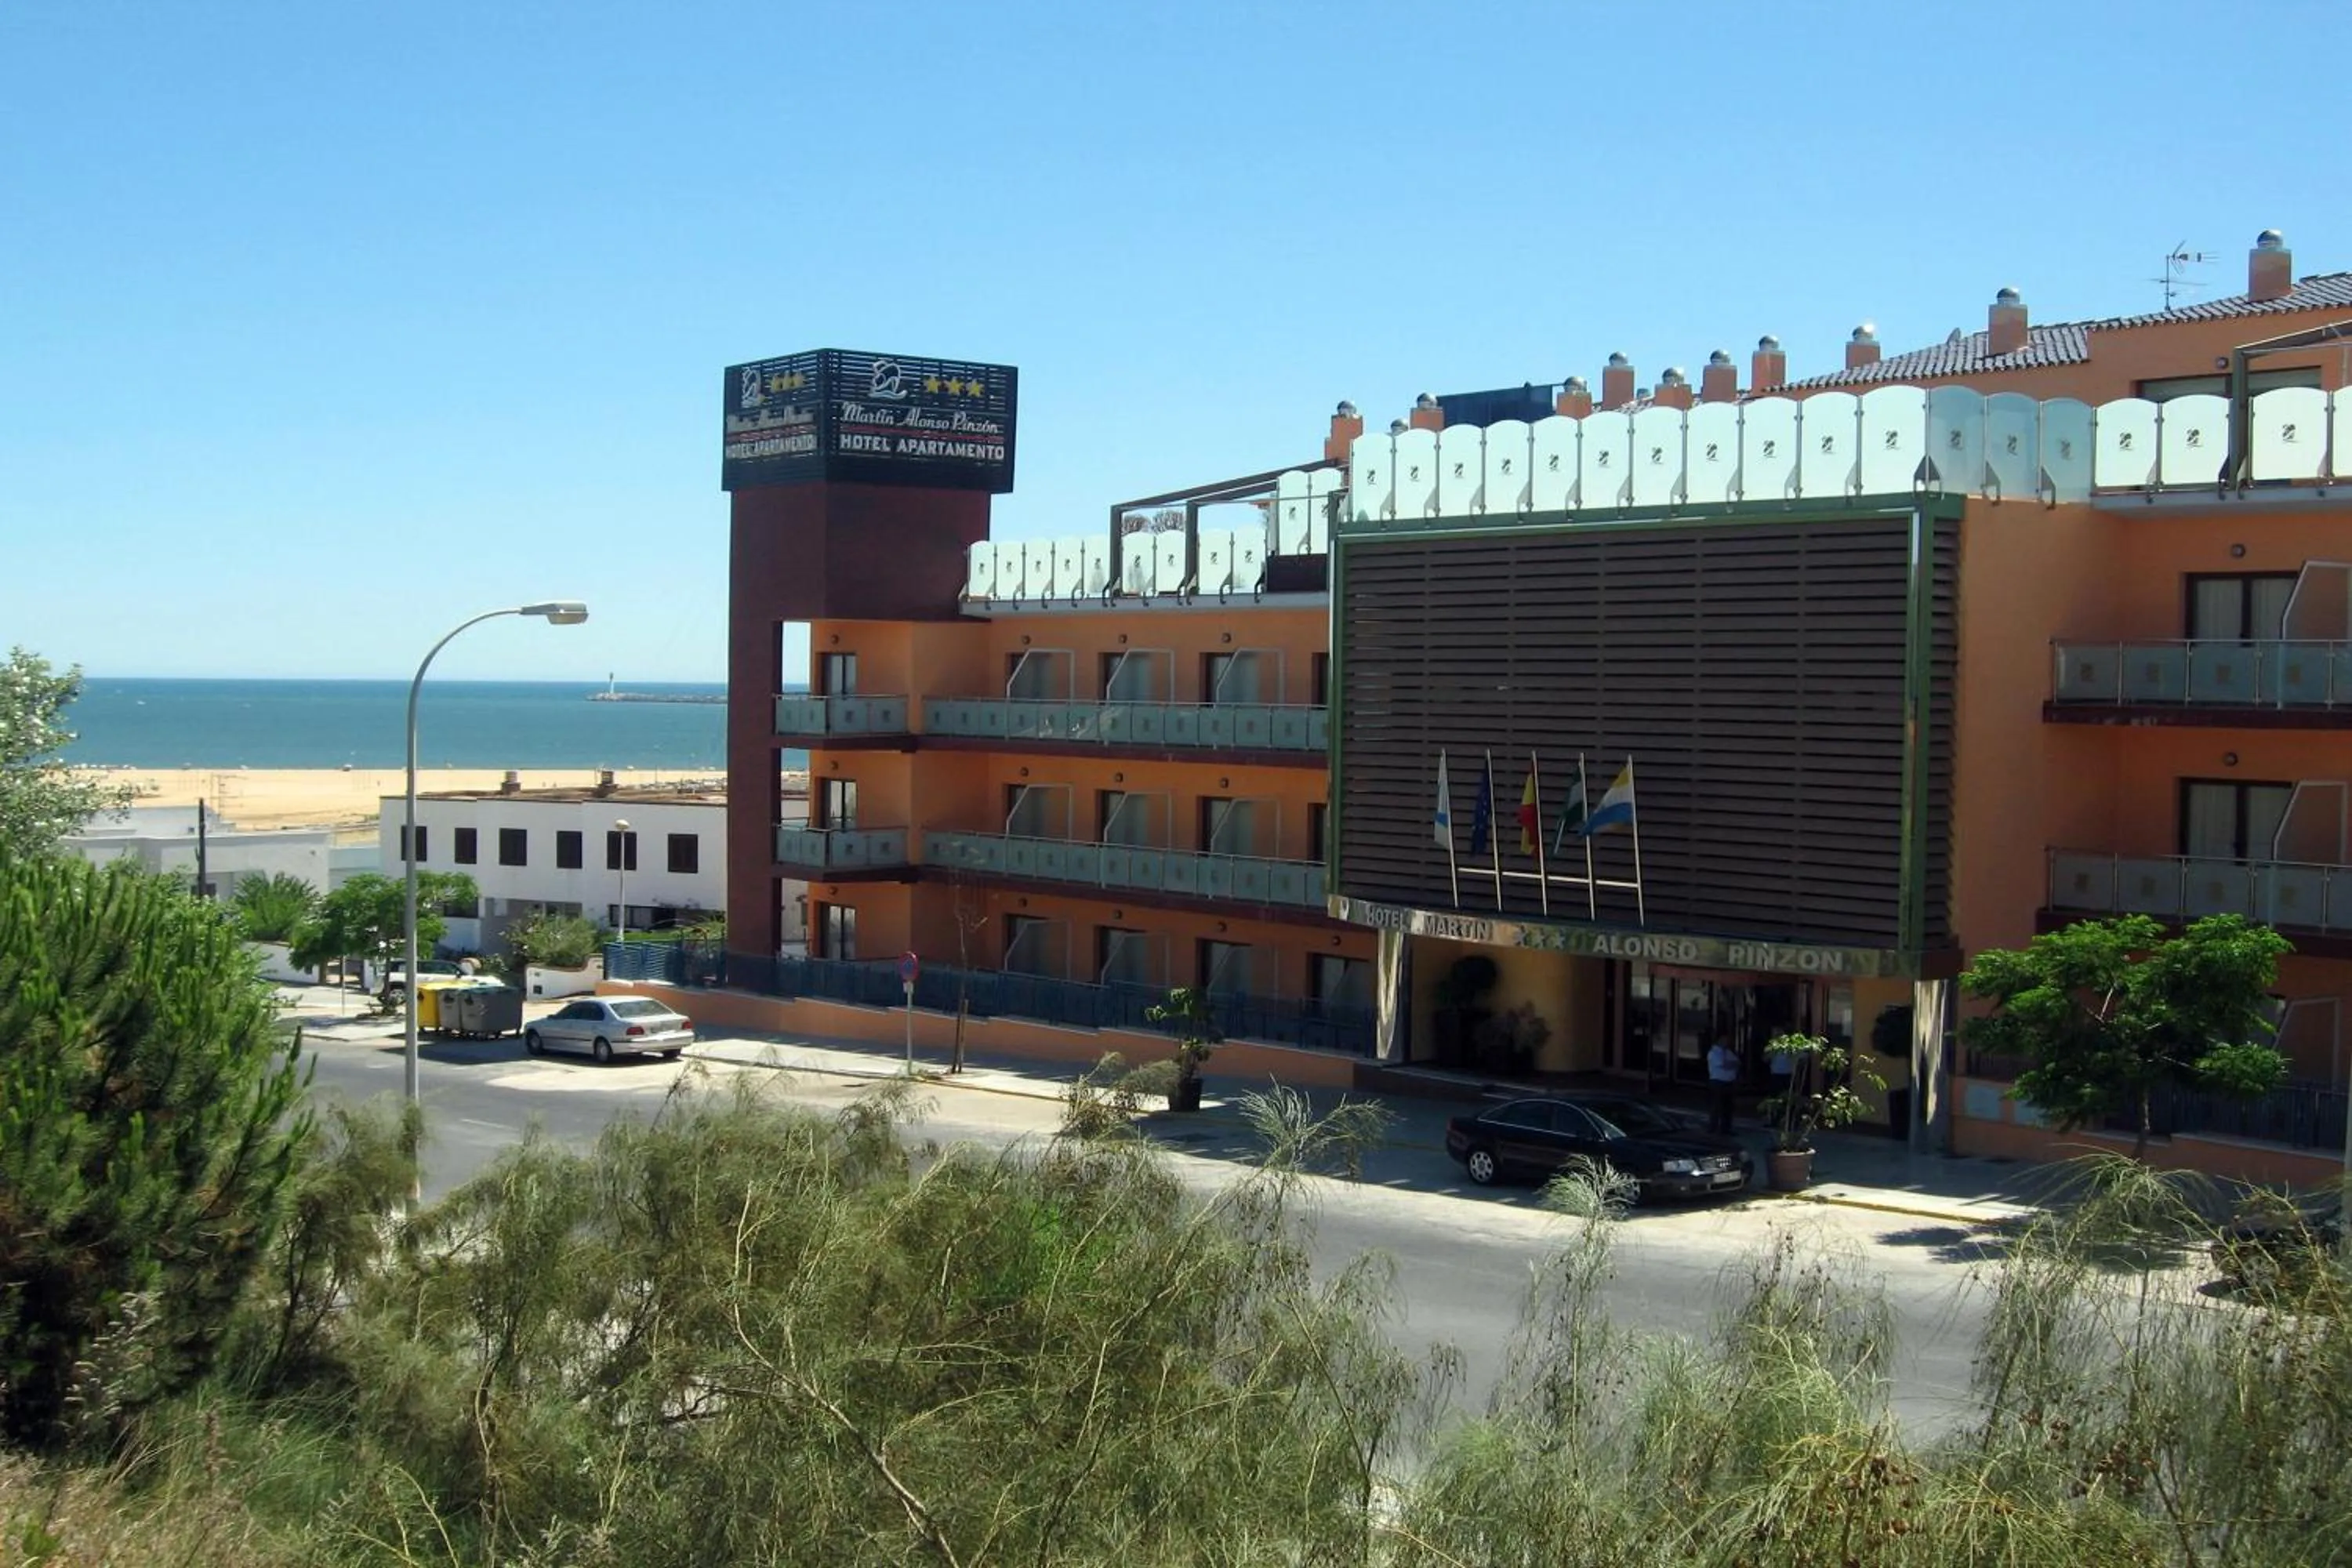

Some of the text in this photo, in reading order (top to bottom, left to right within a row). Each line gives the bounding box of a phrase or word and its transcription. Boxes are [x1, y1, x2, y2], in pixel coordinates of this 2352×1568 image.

[896, 407, 949, 430] Alonso
[839, 434, 1004, 460] HOTEL APARTAMENTO
[1365, 903, 1844, 971] HOTEL MARTIN ALONSO PINZON
